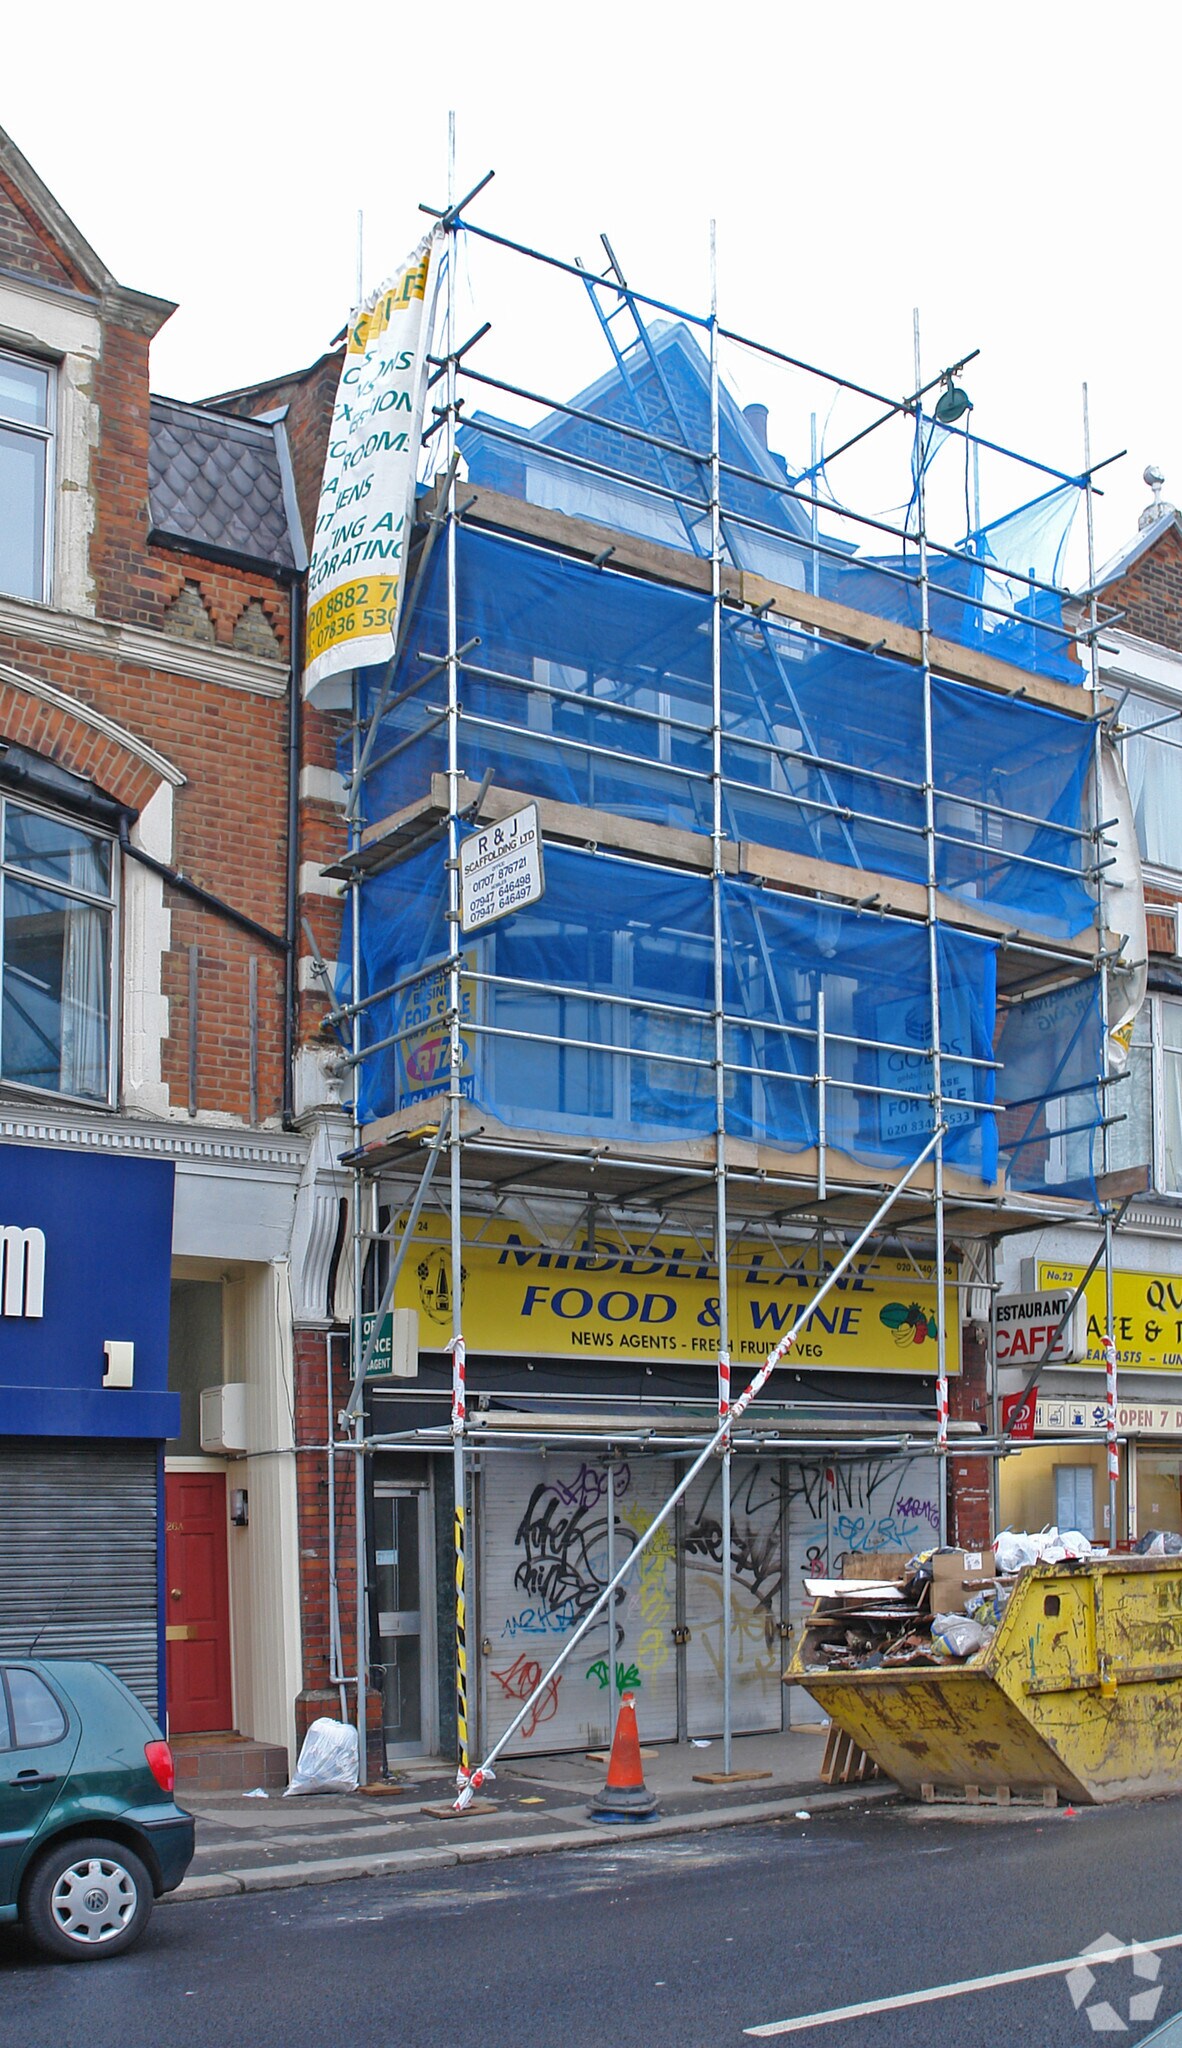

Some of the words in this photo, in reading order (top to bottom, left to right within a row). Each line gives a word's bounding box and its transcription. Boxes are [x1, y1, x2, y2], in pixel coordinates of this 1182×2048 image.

[326, 583, 369, 619] 8882
[317, 612, 355, 648] 07836
[478, 835, 488, 855] R
[494, 828, 504, 846] &
[510, 818, 517, 837] J
[464, 839, 517, 875] SCAFFOLDING
[520, 829, 535, 845] LTD
[472, 873, 495, 893] 01707
[498, 856, 527, 879] 876721
[470, 891, 495, 911] 07947
[498, 873, 531, 897] 646498
[470, 902, 495, 923] 07947
[499, 885, 531, 909] 646497
[927, 1076, 960, 1092] LASE
[888, 1099, 919, 1118] FOR
[887, 1124, 907, 1136] 020
[911, 1117, 936, 1132] 834
[417, 1221, 428, 1231] 24
[498, 1234, 728, 1281] MIDDLE
[745, 1254, 881, 1292] LANE
[896, 1262, 911, 1272] 020
[1046, 1270, 1074, 1282] No.22
[520, 1285, 678, 1323] FOOD
[697, 1297, 729, 1327] &
[750, 1301, 863, 1335] WINE
[989, 1299, 1068, 1322] ESTAURANT
[571, 1331, 614, 1346] NEWS
[619, 1334, 677, 1350] AGENTS
[692, 1337, 734, 1353] FRESH
[796, 1344, 823, 1357] VEG
[996, 1325, 1064, 1358] CAFE
[1145, 1320, 1163, 1343] &
[1119, 1410, 1153, 1427] OPEN
[1160, 1411, 1169, 1427] 7
